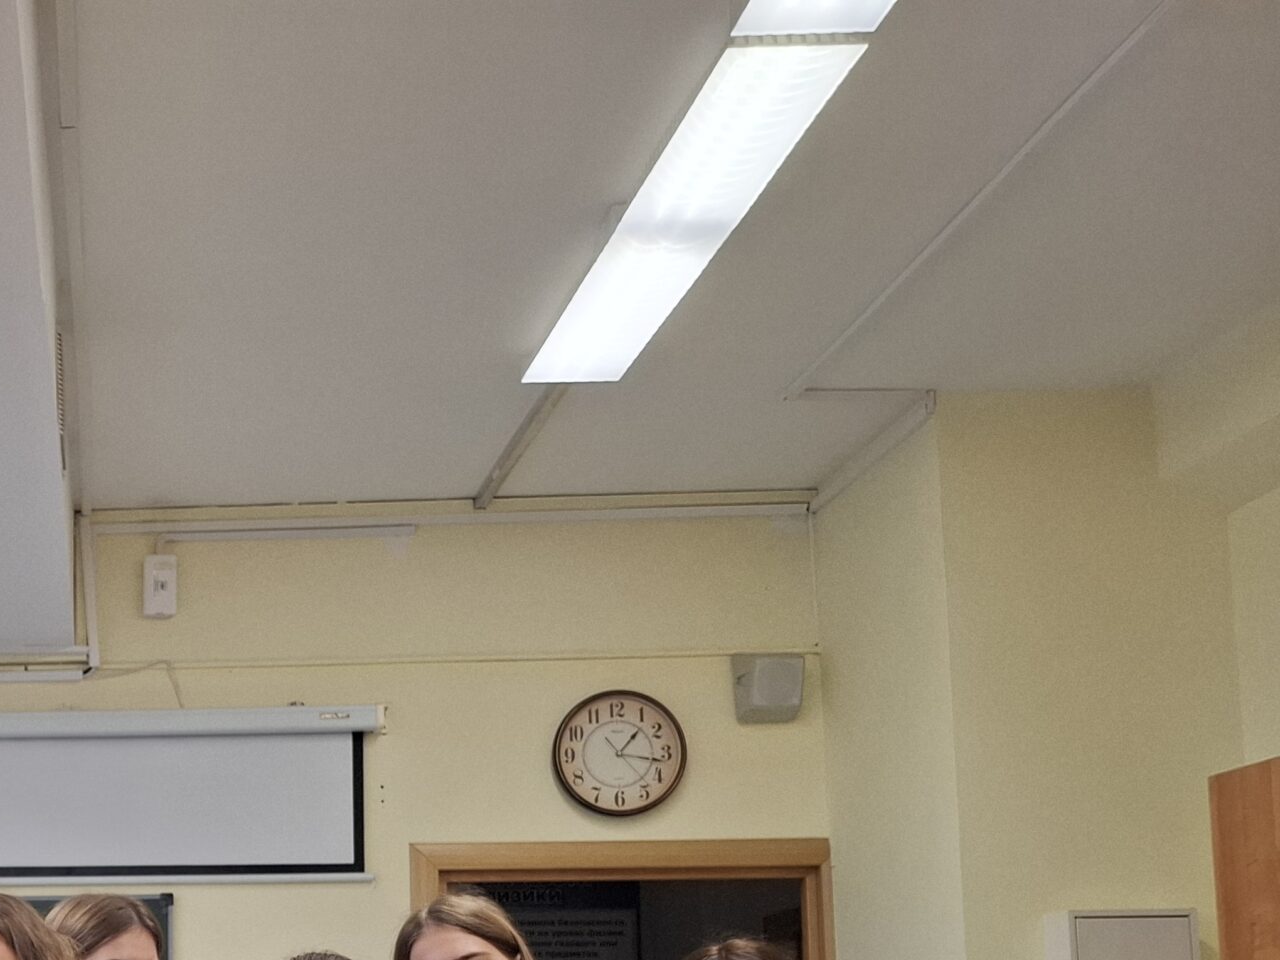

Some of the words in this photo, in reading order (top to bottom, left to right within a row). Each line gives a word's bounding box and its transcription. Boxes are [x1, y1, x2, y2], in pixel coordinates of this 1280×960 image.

[588, 708, 599, 724] 11
[610, 701, 625, 718] 12
[639, 706, 644, 722] 1
[569, 725, 584, 742] 10
[651, 722, 662, 739] 2
[564, 747, 575, 763] 9
[660, 744, 672, 761] 3
[573, 768, 584, 786] 8
[653, 766, 662, 783] 4
[592, 786, 601, 804] 7
[614, 790, 625, 807] 6
[639, 783, 650, 800] 5
